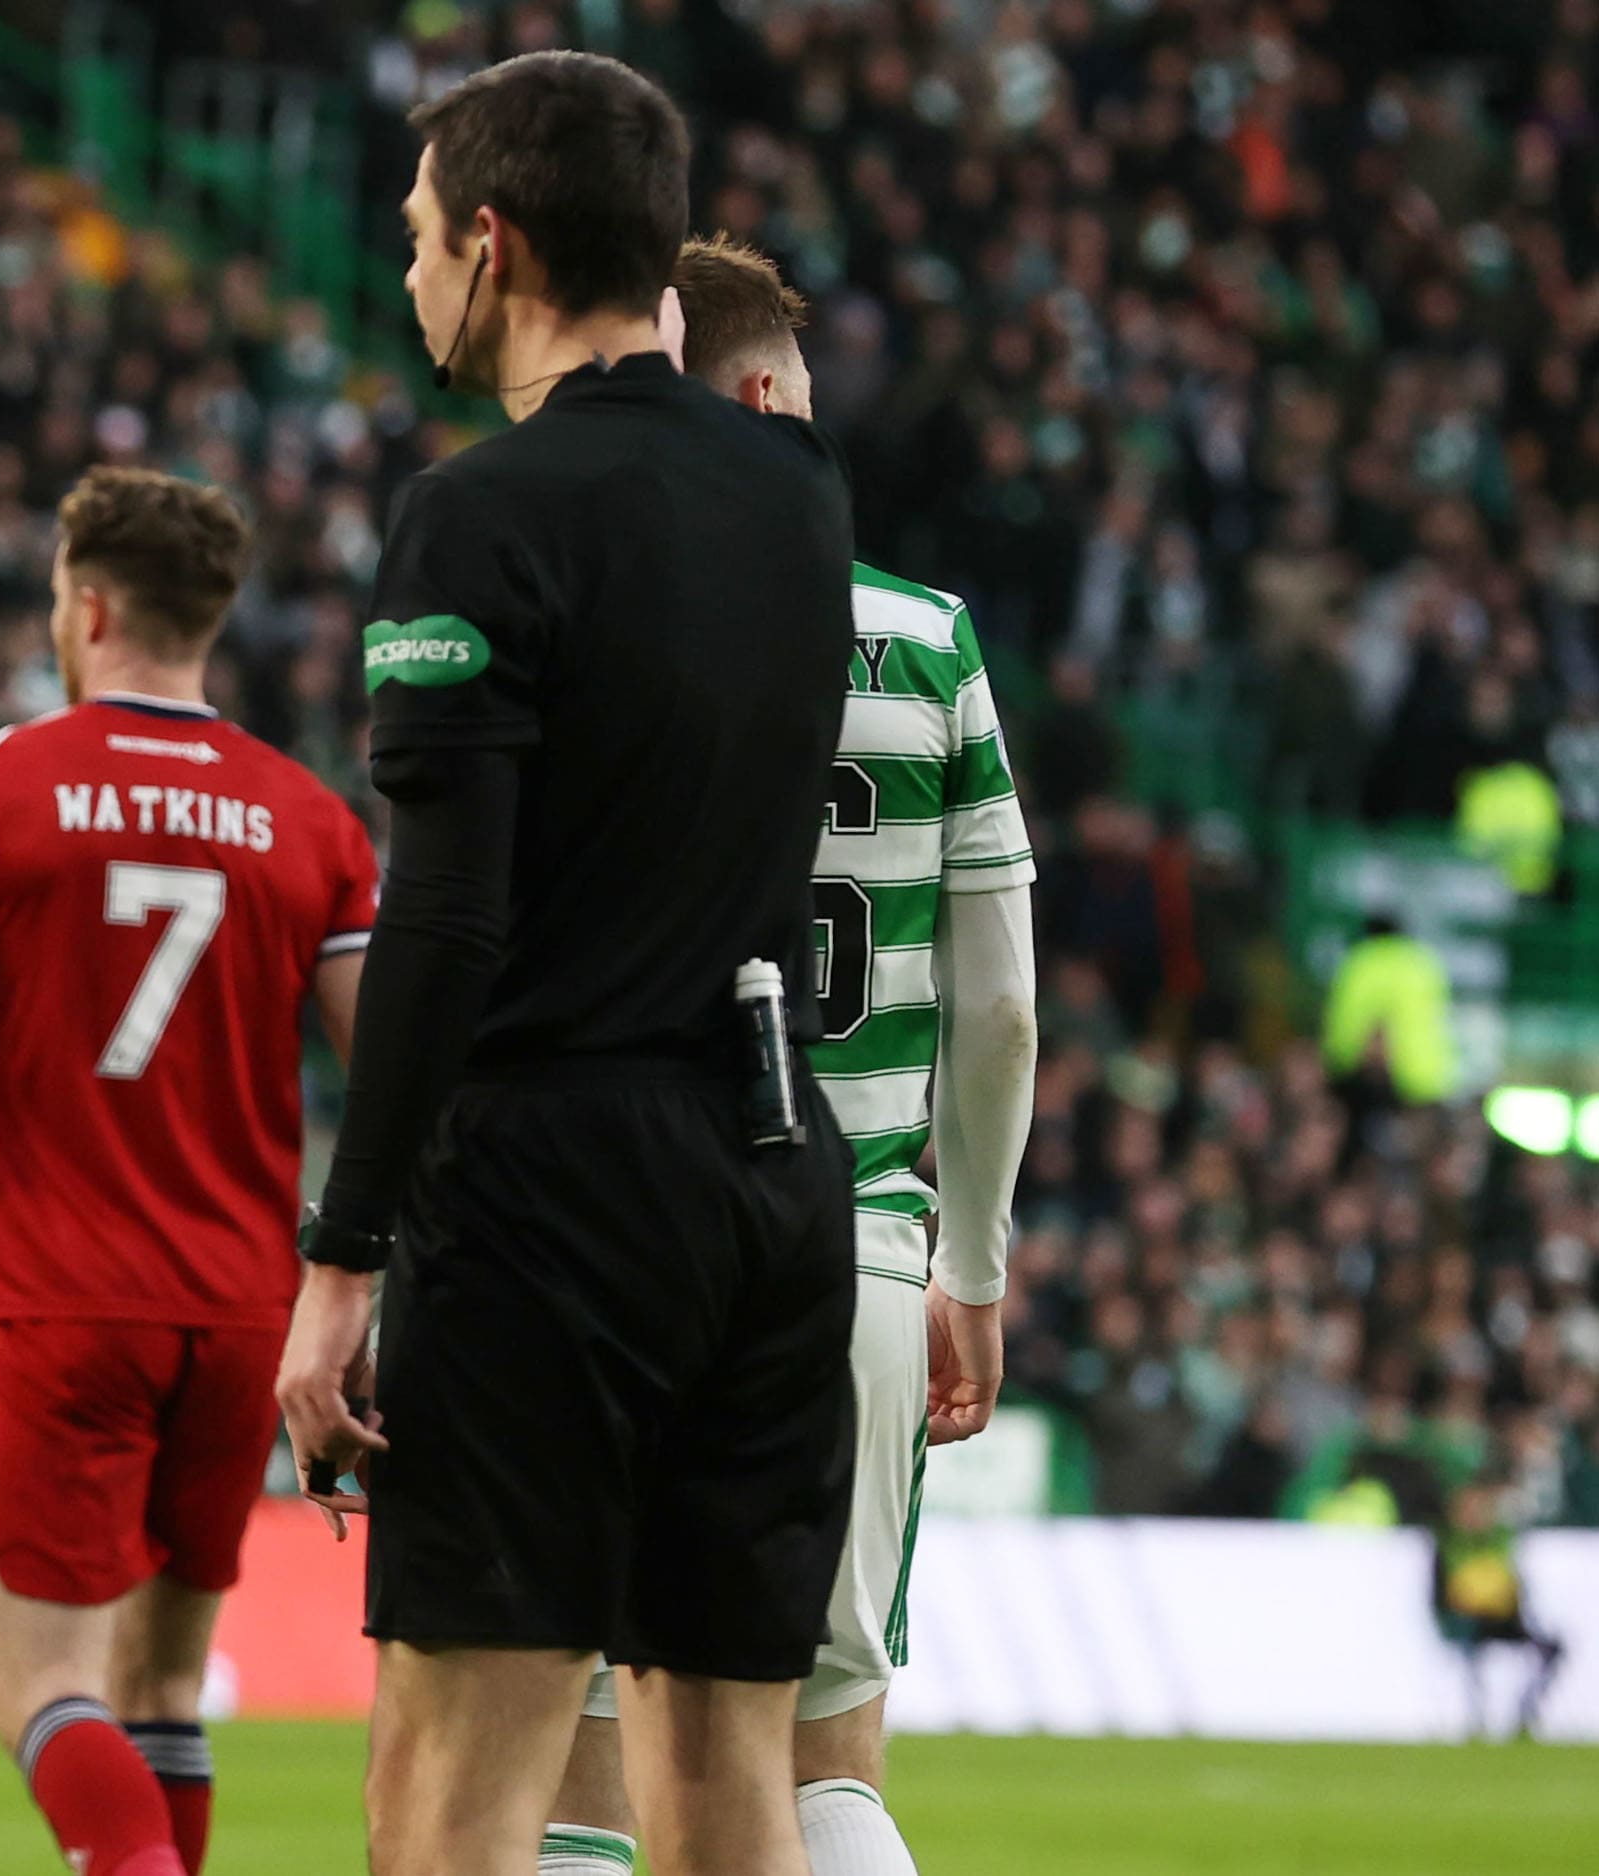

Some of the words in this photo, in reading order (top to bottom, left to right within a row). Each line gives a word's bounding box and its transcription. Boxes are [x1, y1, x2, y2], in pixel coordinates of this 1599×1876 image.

[846, 637, 891, 693] Y
[54, 783, 275, 853] WATKINS
[95, 860, 228, 1081] 7
